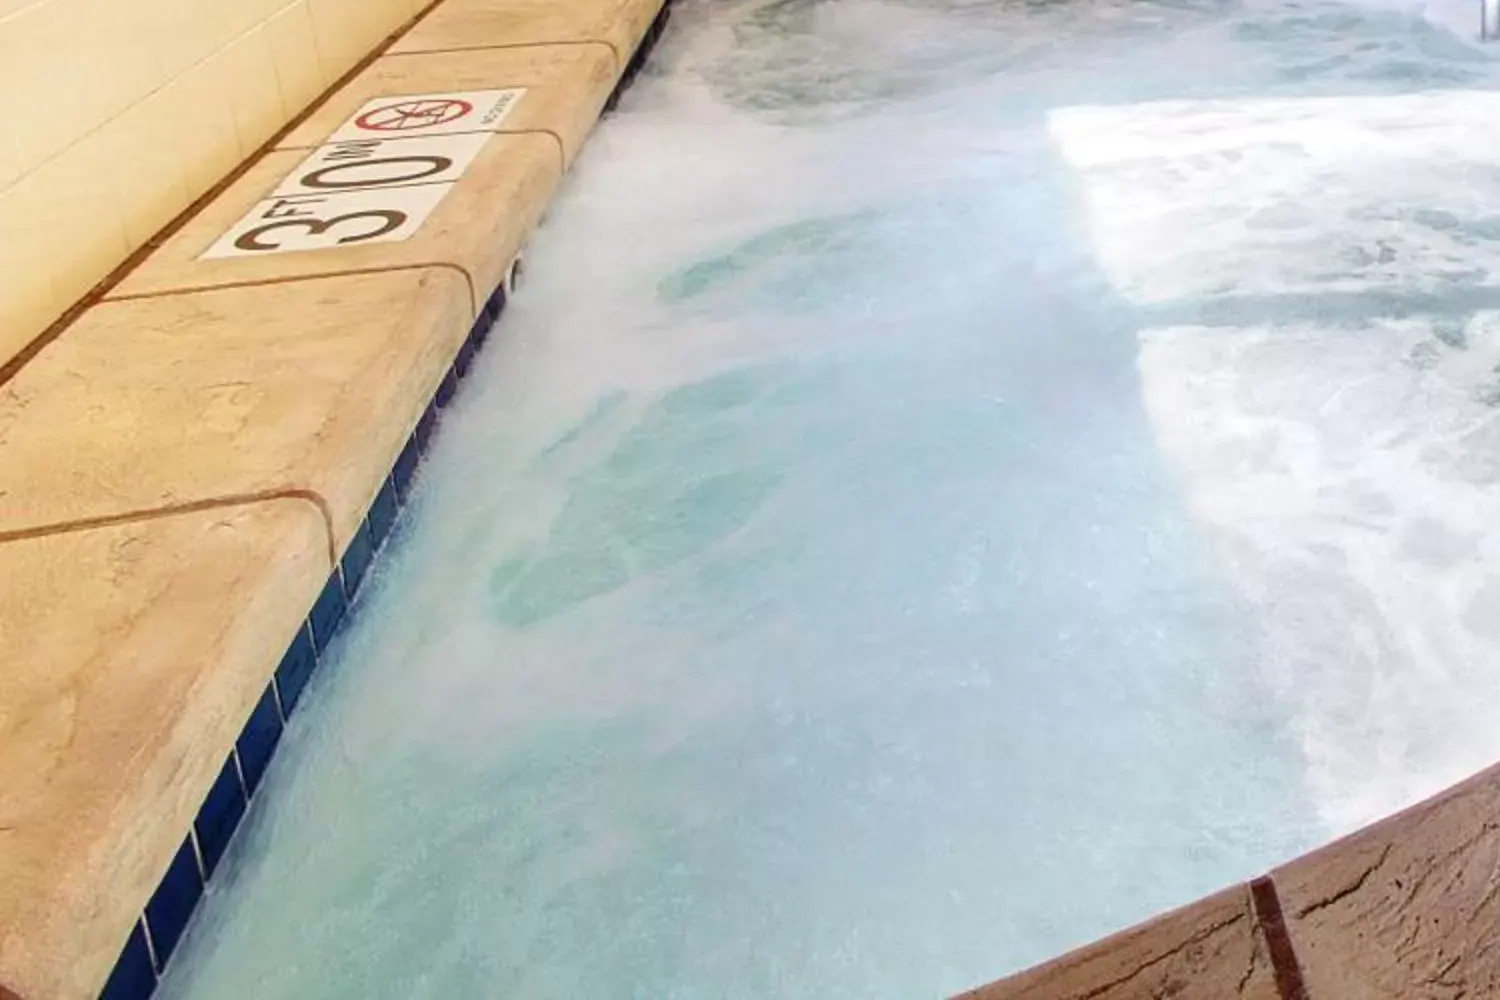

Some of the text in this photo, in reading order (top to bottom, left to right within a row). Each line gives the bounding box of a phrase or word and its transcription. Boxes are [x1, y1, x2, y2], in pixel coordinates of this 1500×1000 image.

[299, 155, 453, 188] 0
[260, 198, 328, 220] FT
[233, 208, 408, 251] 3
